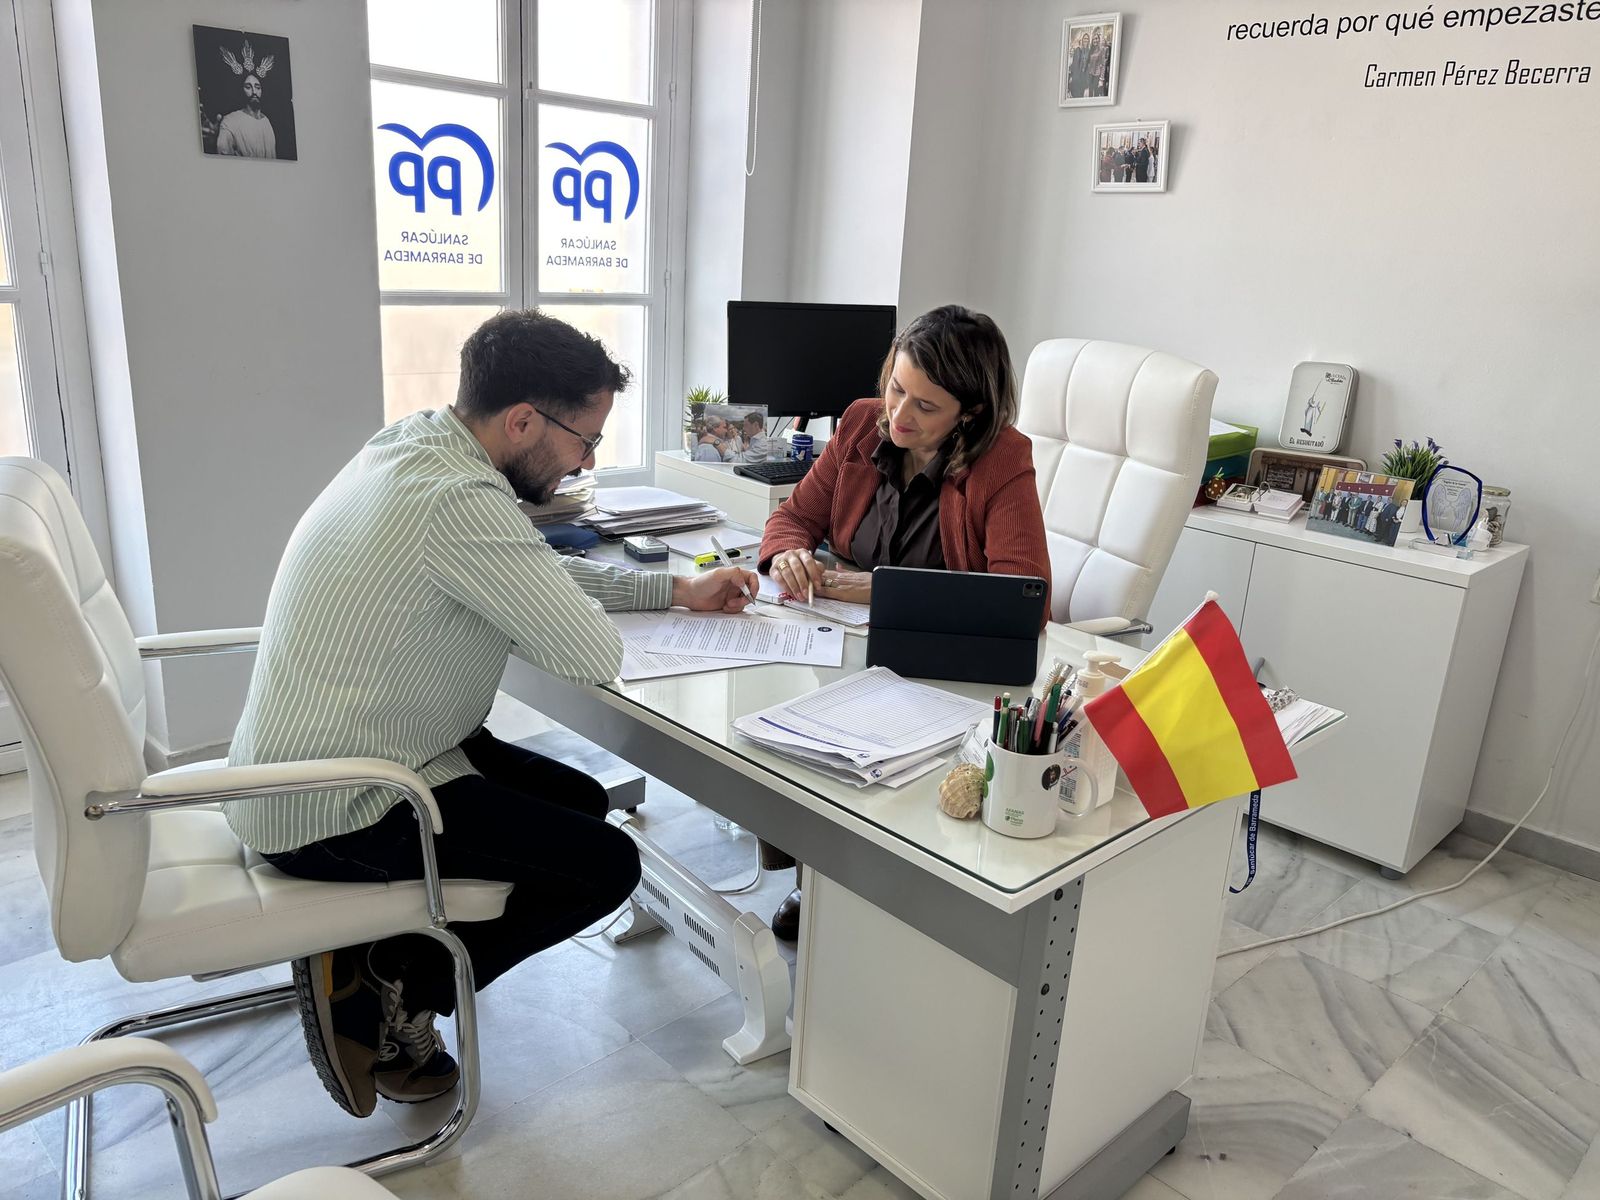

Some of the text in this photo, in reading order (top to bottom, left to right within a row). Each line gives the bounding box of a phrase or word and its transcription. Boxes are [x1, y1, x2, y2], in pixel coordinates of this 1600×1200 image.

[1227, 0, 1600, 40] recuerda por qué empezaste
[1364, 59, 1592, 88] Carmen Pérez Becerra
[1248, 794, 1260, 831] Barrameda
